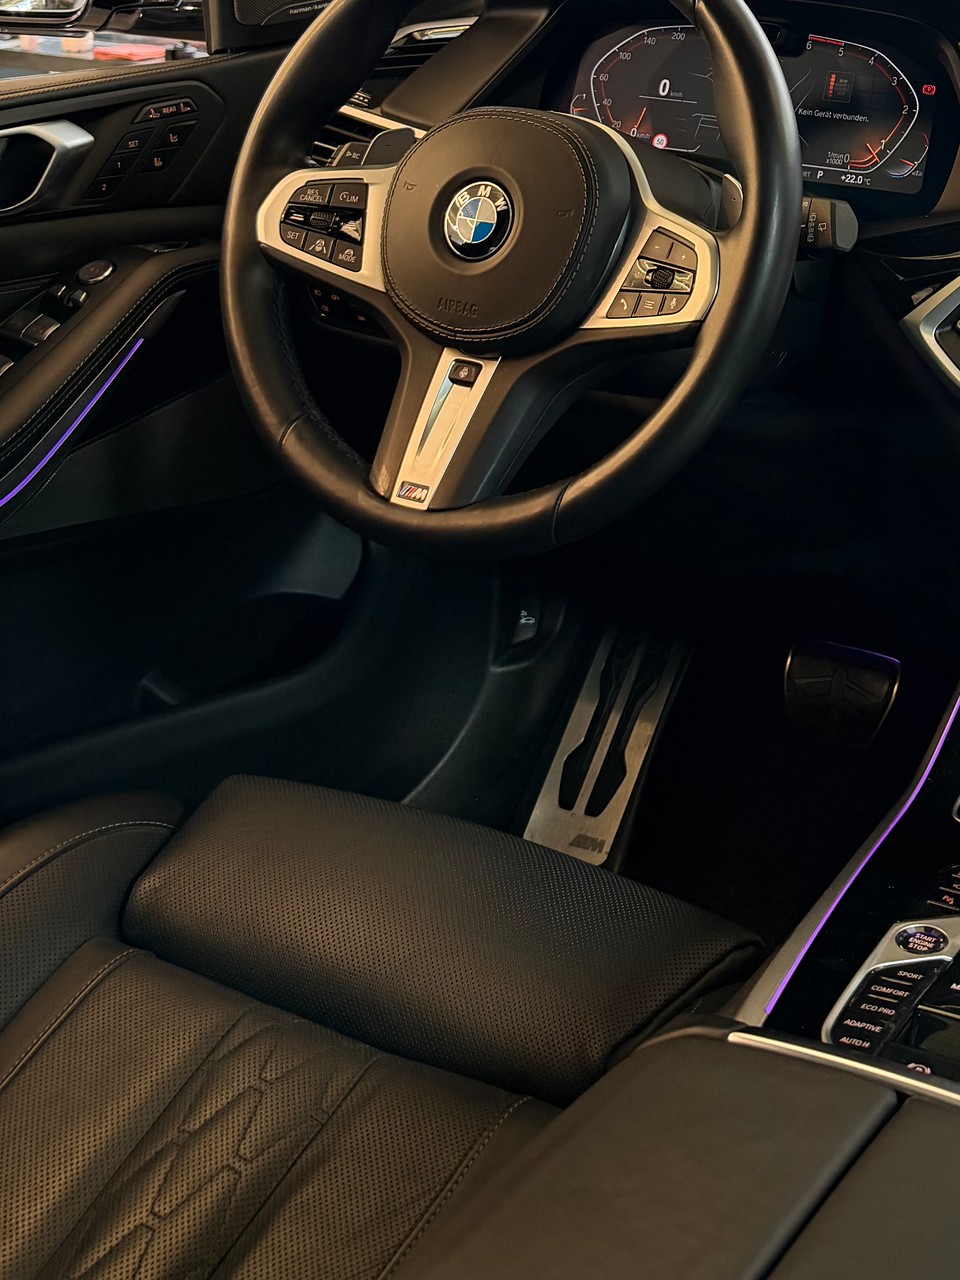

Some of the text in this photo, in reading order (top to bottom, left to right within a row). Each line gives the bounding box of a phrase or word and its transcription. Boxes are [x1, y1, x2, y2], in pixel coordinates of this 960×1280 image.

[644, 36, 656, 45] 140
[671, 32, 686, 41] 200
[805, 40, 812, 50] 6
[619, 51, 632, 60] 100
[838, 47, 845, 57] 5
[868, 56, 875, 66] 4
[599, 73, 609, 82] 60
[891, 76, 898, 86] 3
[658, 78, 671, 97] 0
[602, 98, 613, 107] 40
[162, 105, 177, 114] REAR
[901, 105, 909, 115] 2
[798, 107, 870, 123] Kein Gerät verbunden.
[612, 120, 622, 129] 20
[630, 127, 637, 138] 0
[128, 140, 139, 148] SET
[656, 137, 665, 146] 50
[880, 138, 887, 149] 1
[843, 153, 850, 163] 0
[816, 170, 824, 180] P
[840, 173, 863, 184] +22.0
[101, 183, 107, 191] 2
[307, 188, 319, 196] RES
[299, 194, 324, 203] CANCEL
[346, 195, 359, 203] LIM
[455, 185, 508, 212] BMW
[286, 230, 300, 240] SET
[338, 253, 357, 263] MODE
[437, 296, 479, 318] AIRBAG
[908, 937, 936, 949] ENGINE
[914, 932, 936, 944] START
[907, 942, 929, 952] STOP
[897, 970, 925, 981] SPORT
[870, 984, 911, 998] COMFORT
[860, 1002, 897, 1016] ECO PRO
[843, 1017, 884, 1033] ADAPTIVE
[839, 1035, 871, 1049] AUTO H
